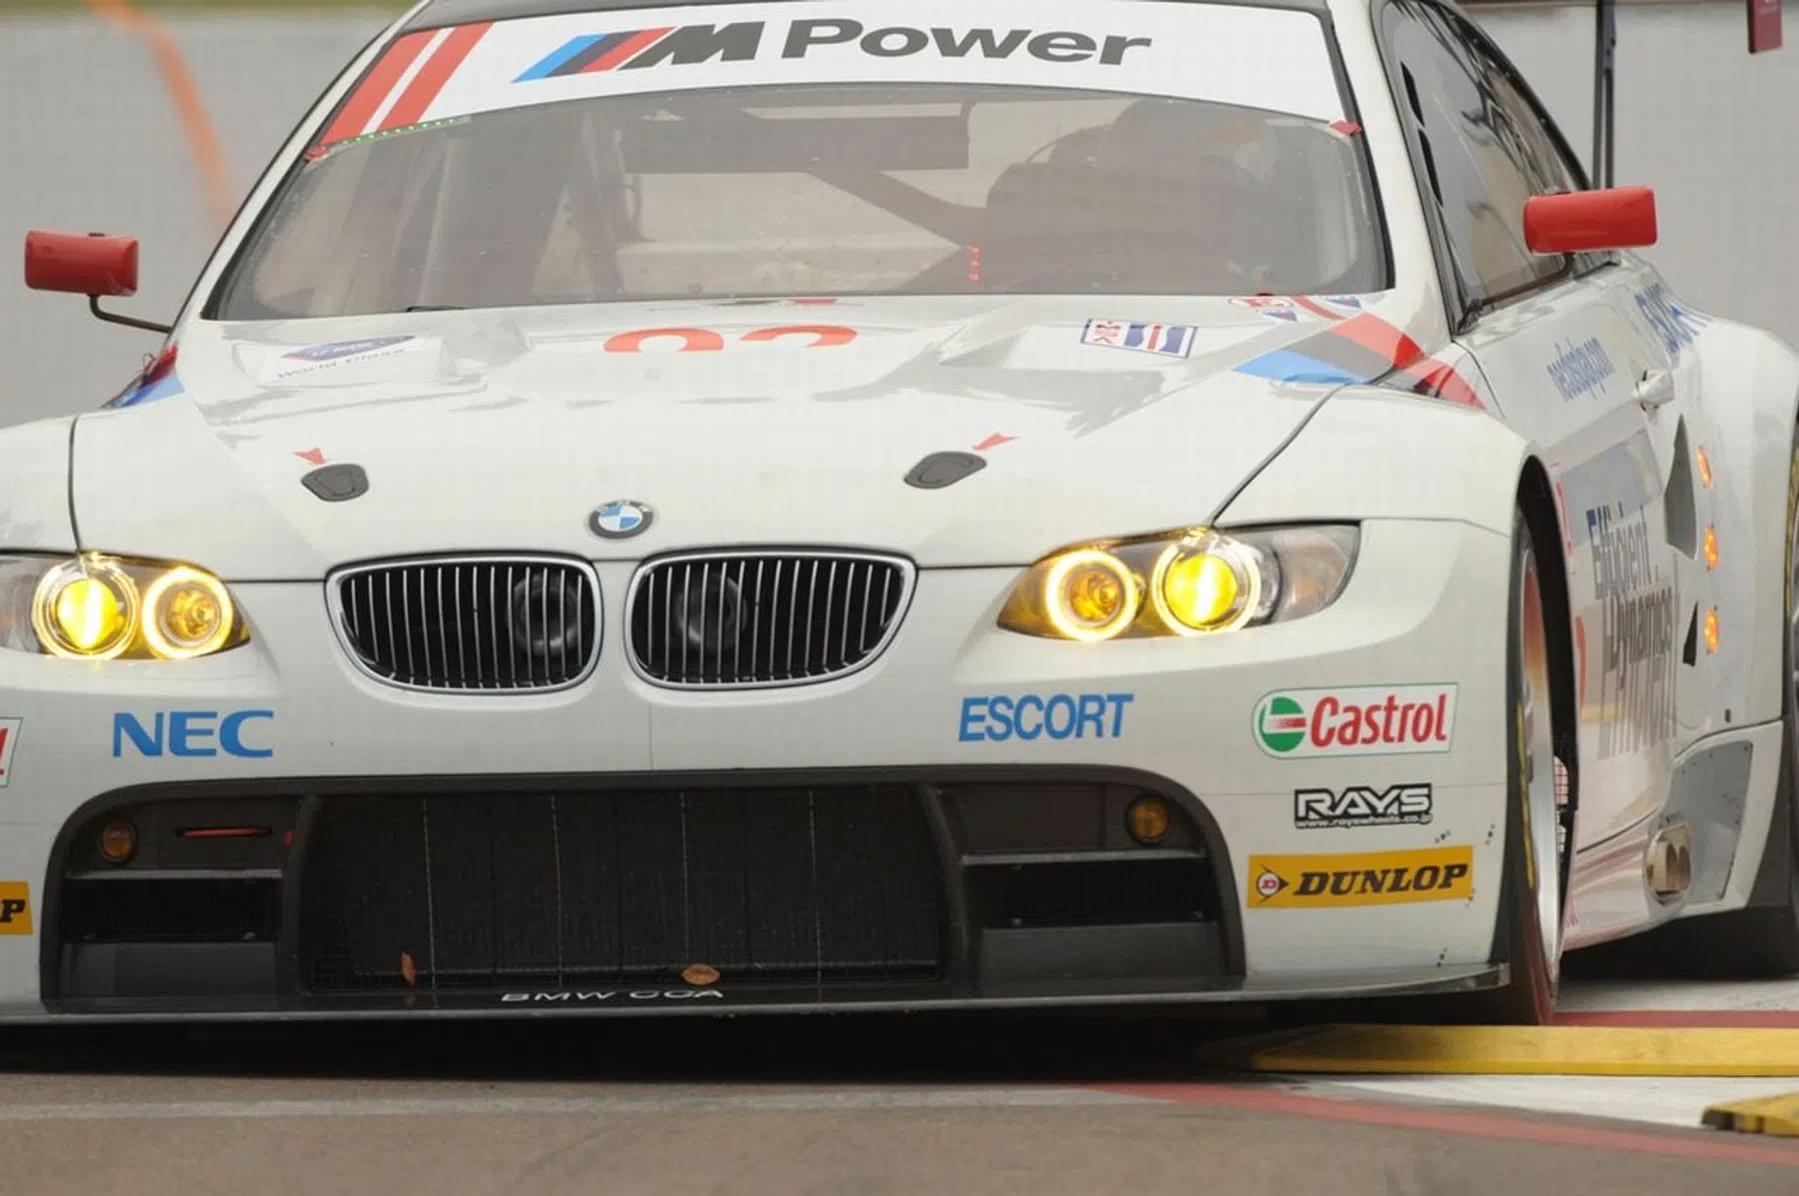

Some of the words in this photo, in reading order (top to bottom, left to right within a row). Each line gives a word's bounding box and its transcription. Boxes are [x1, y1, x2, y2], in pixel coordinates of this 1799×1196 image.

[617, 20, 765, 70] M
[780, 18, 1153, 66] Power
[112, 709, 274, 758] NEC
[958, 693, 1134, 742] ESCORT
[1310, 693, 1448, 749] Castrol
[1295, 783, 1432, 819] RAYS
[1293, 863, 1468, 896] DUNLOP
[501, 991, 617, 1002] BMW
